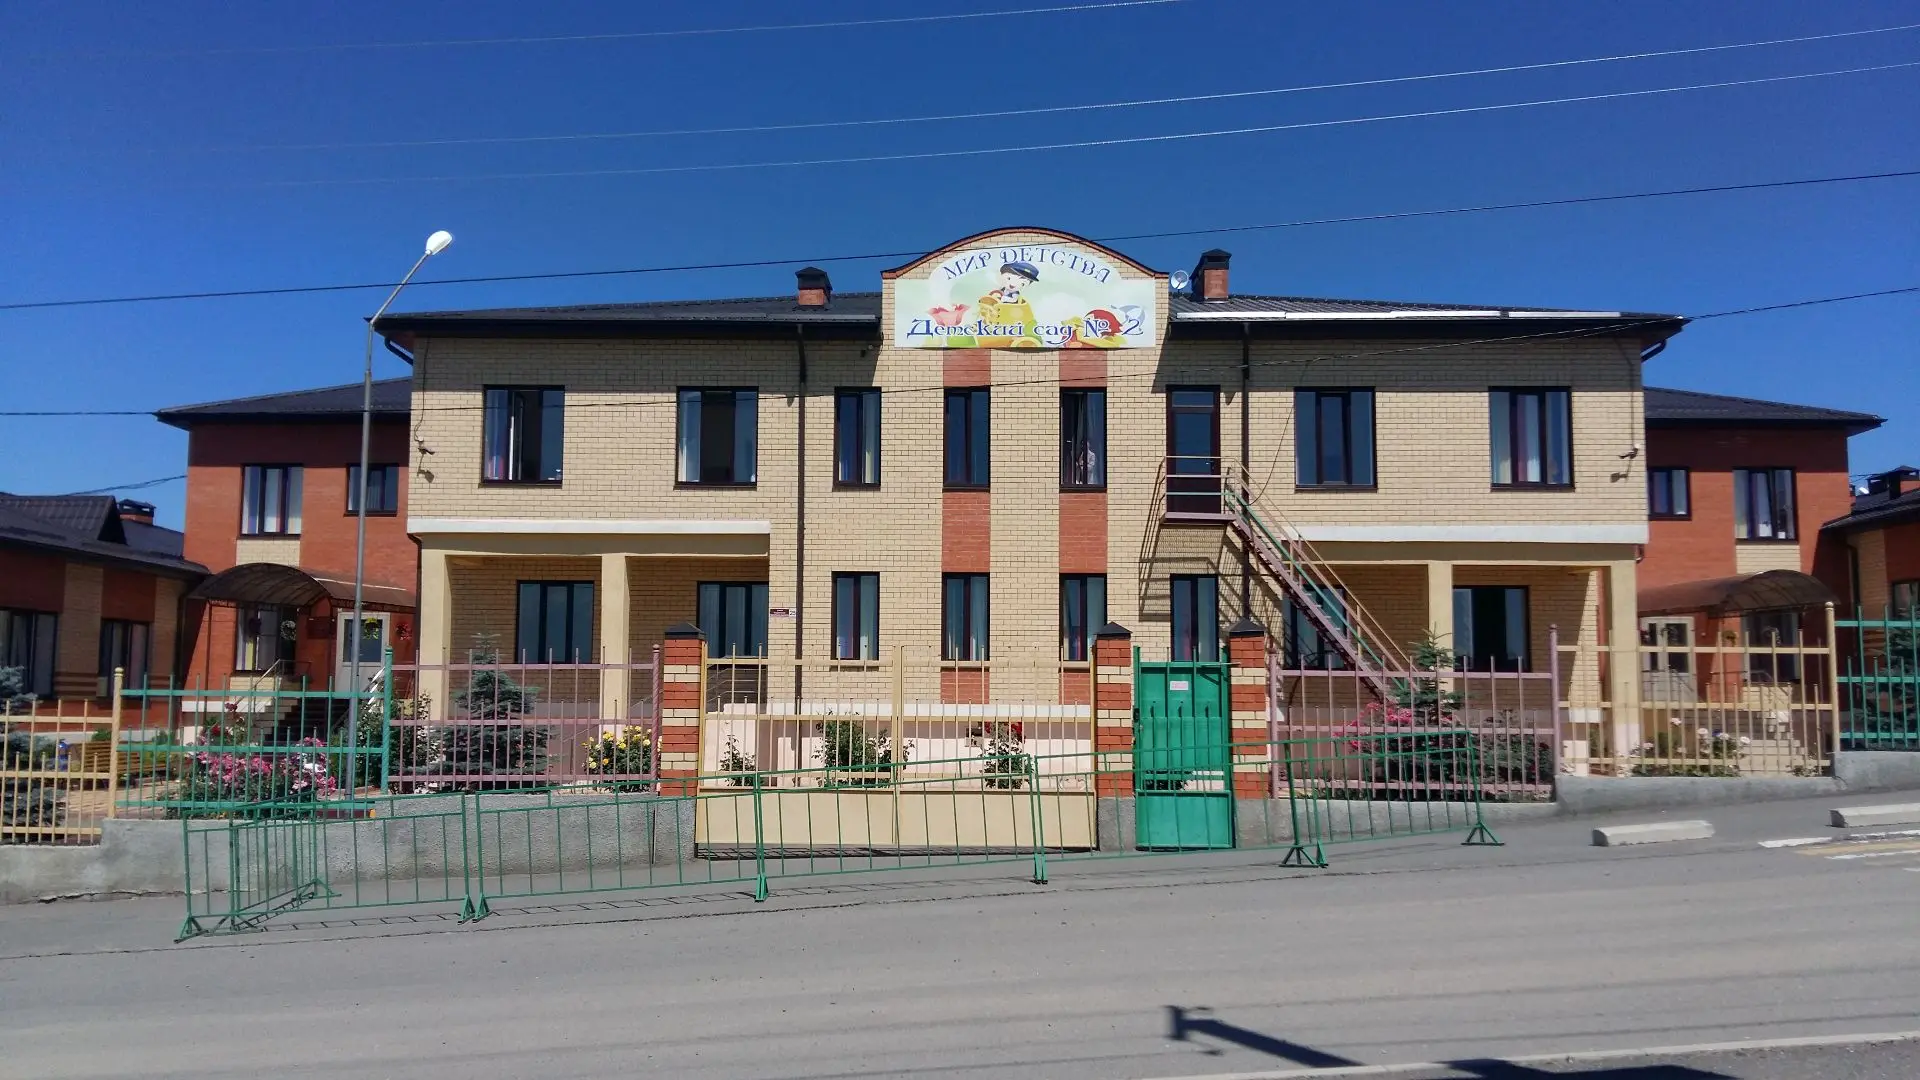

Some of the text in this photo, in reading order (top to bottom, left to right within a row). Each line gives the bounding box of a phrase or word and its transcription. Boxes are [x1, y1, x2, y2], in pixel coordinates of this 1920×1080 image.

[943, 247, 1111, 284] МИР ДЕТСТВА
[906, 317, 1144, 345] Детский сад № 2
